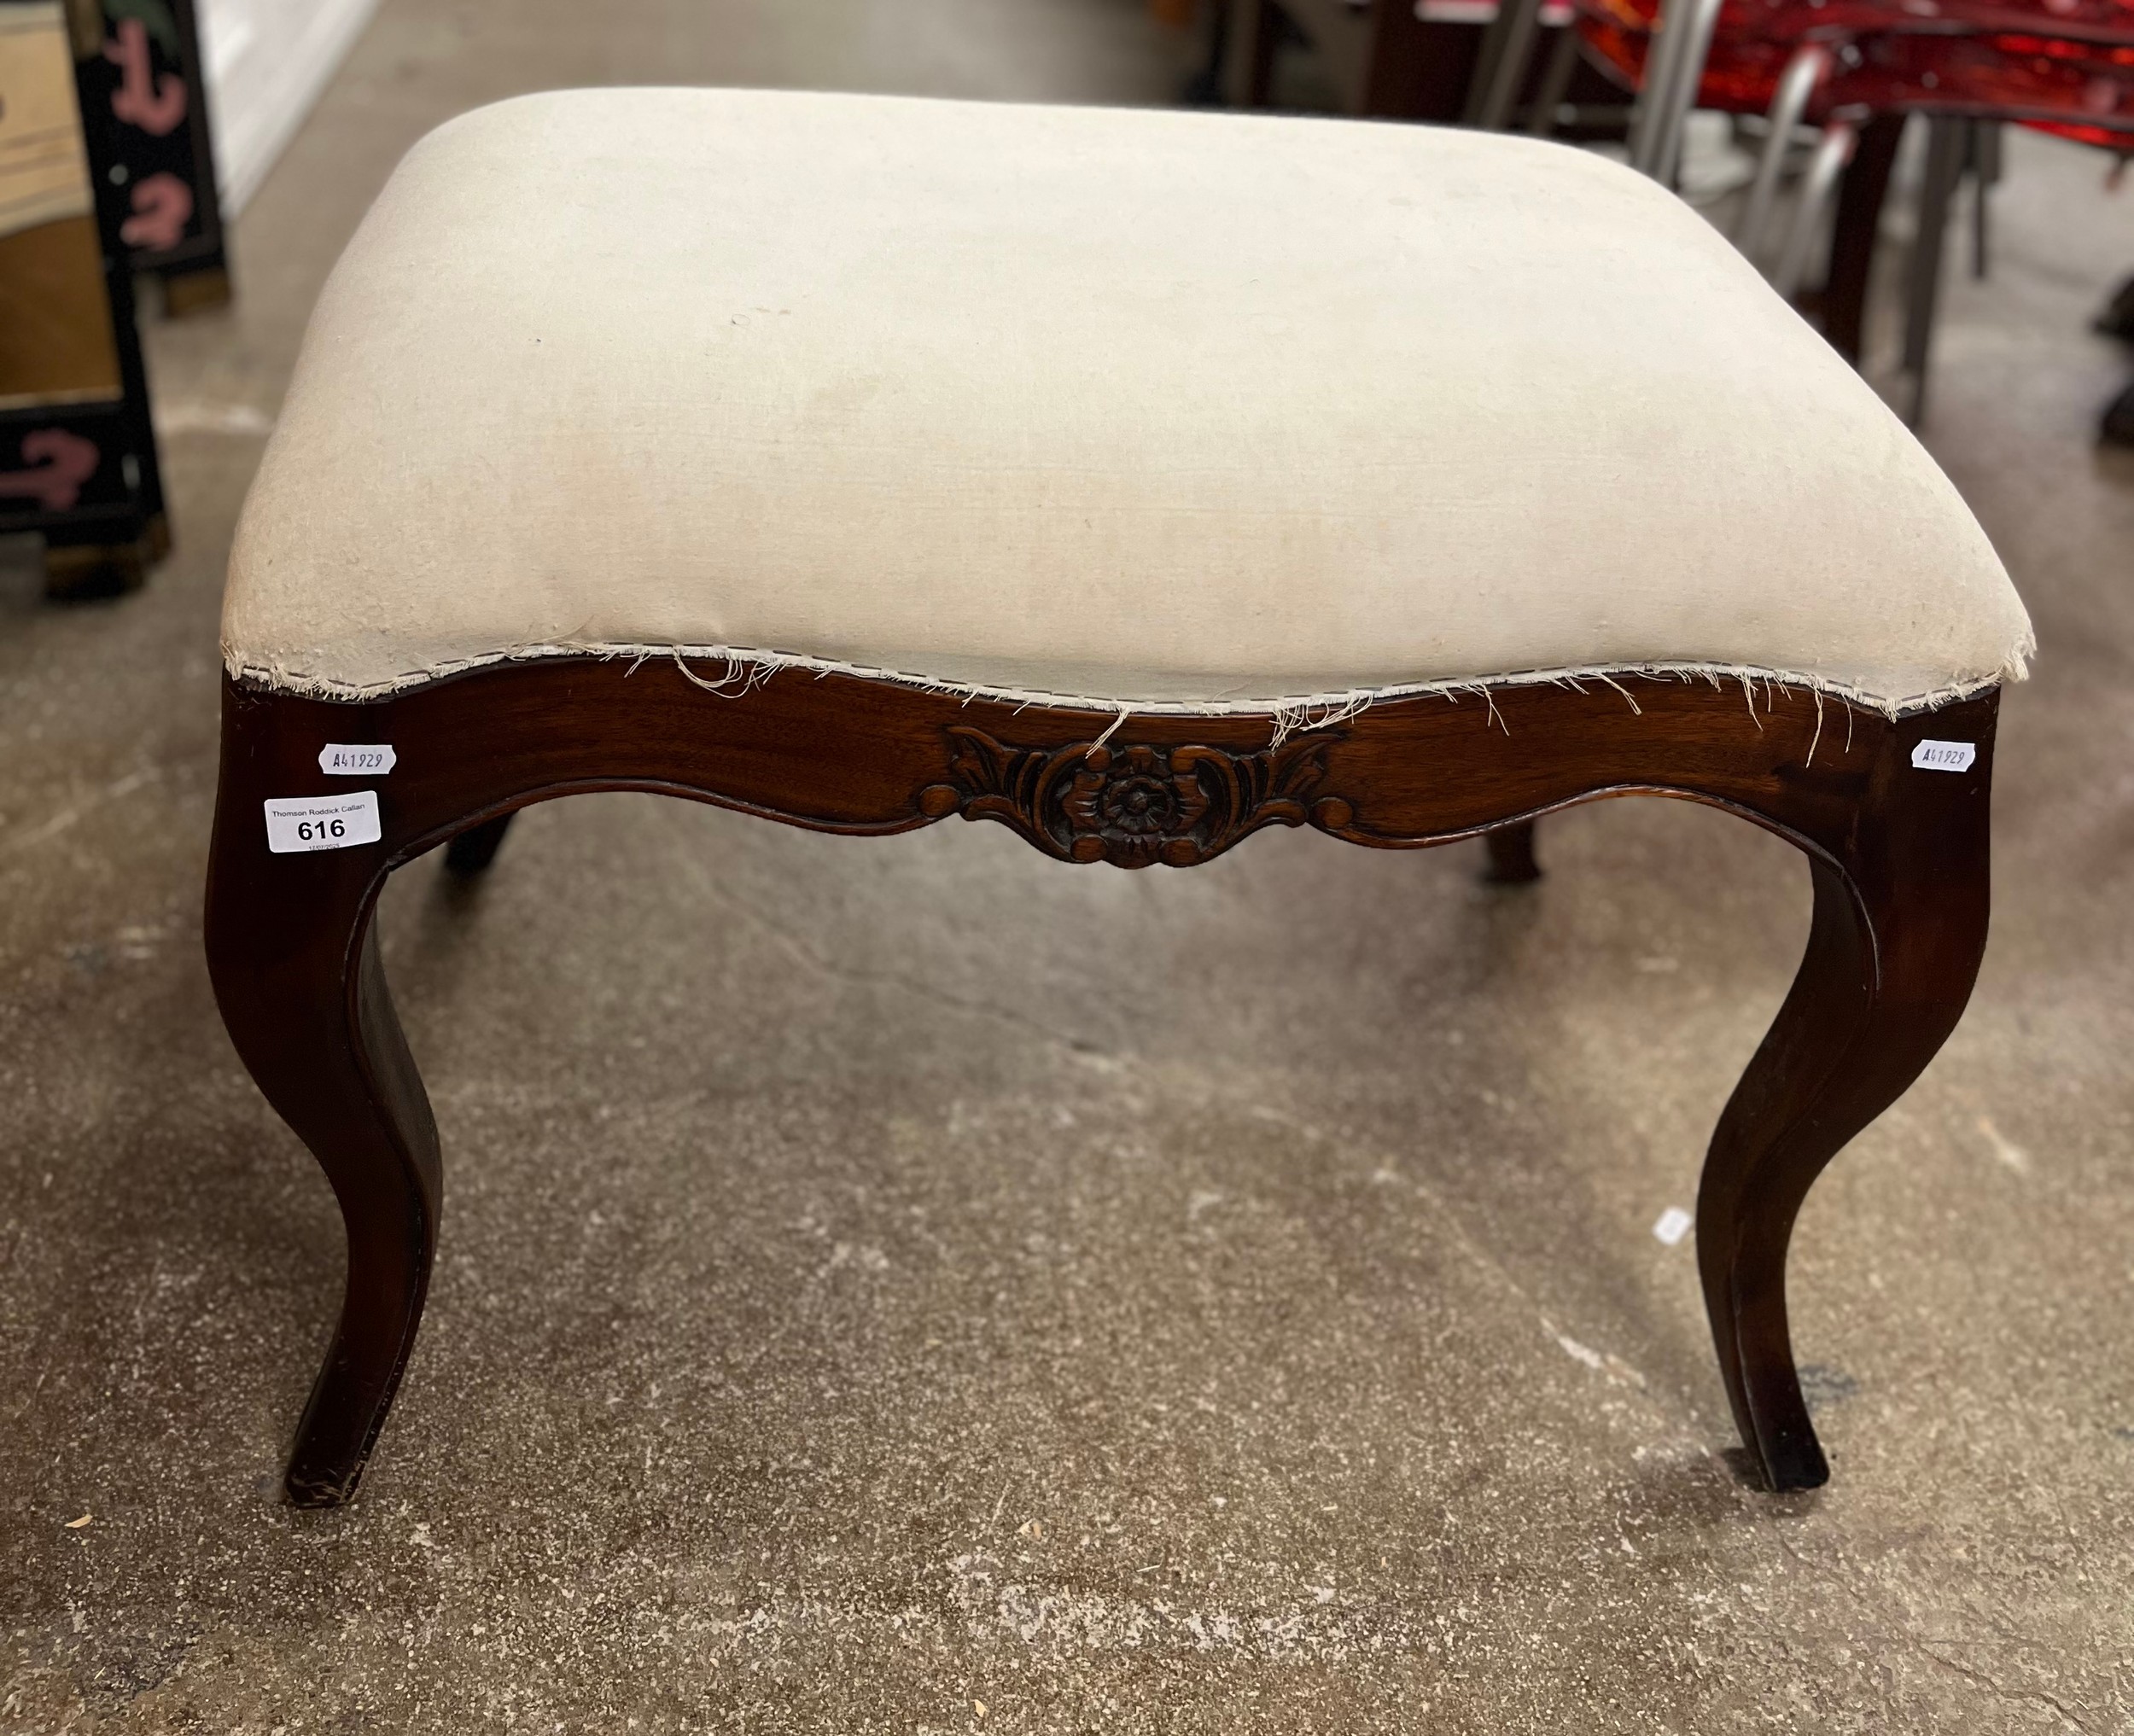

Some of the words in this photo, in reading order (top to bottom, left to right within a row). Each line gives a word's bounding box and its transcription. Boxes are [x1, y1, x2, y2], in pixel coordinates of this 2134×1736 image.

[333, 753, 382, 767] A41929
[1922, 749, 1965, 764] A41929
[309, 807, 340, 815] Roddick
[341, 802, 365, 813] Callan
[298, 818, 346, 841] 616
